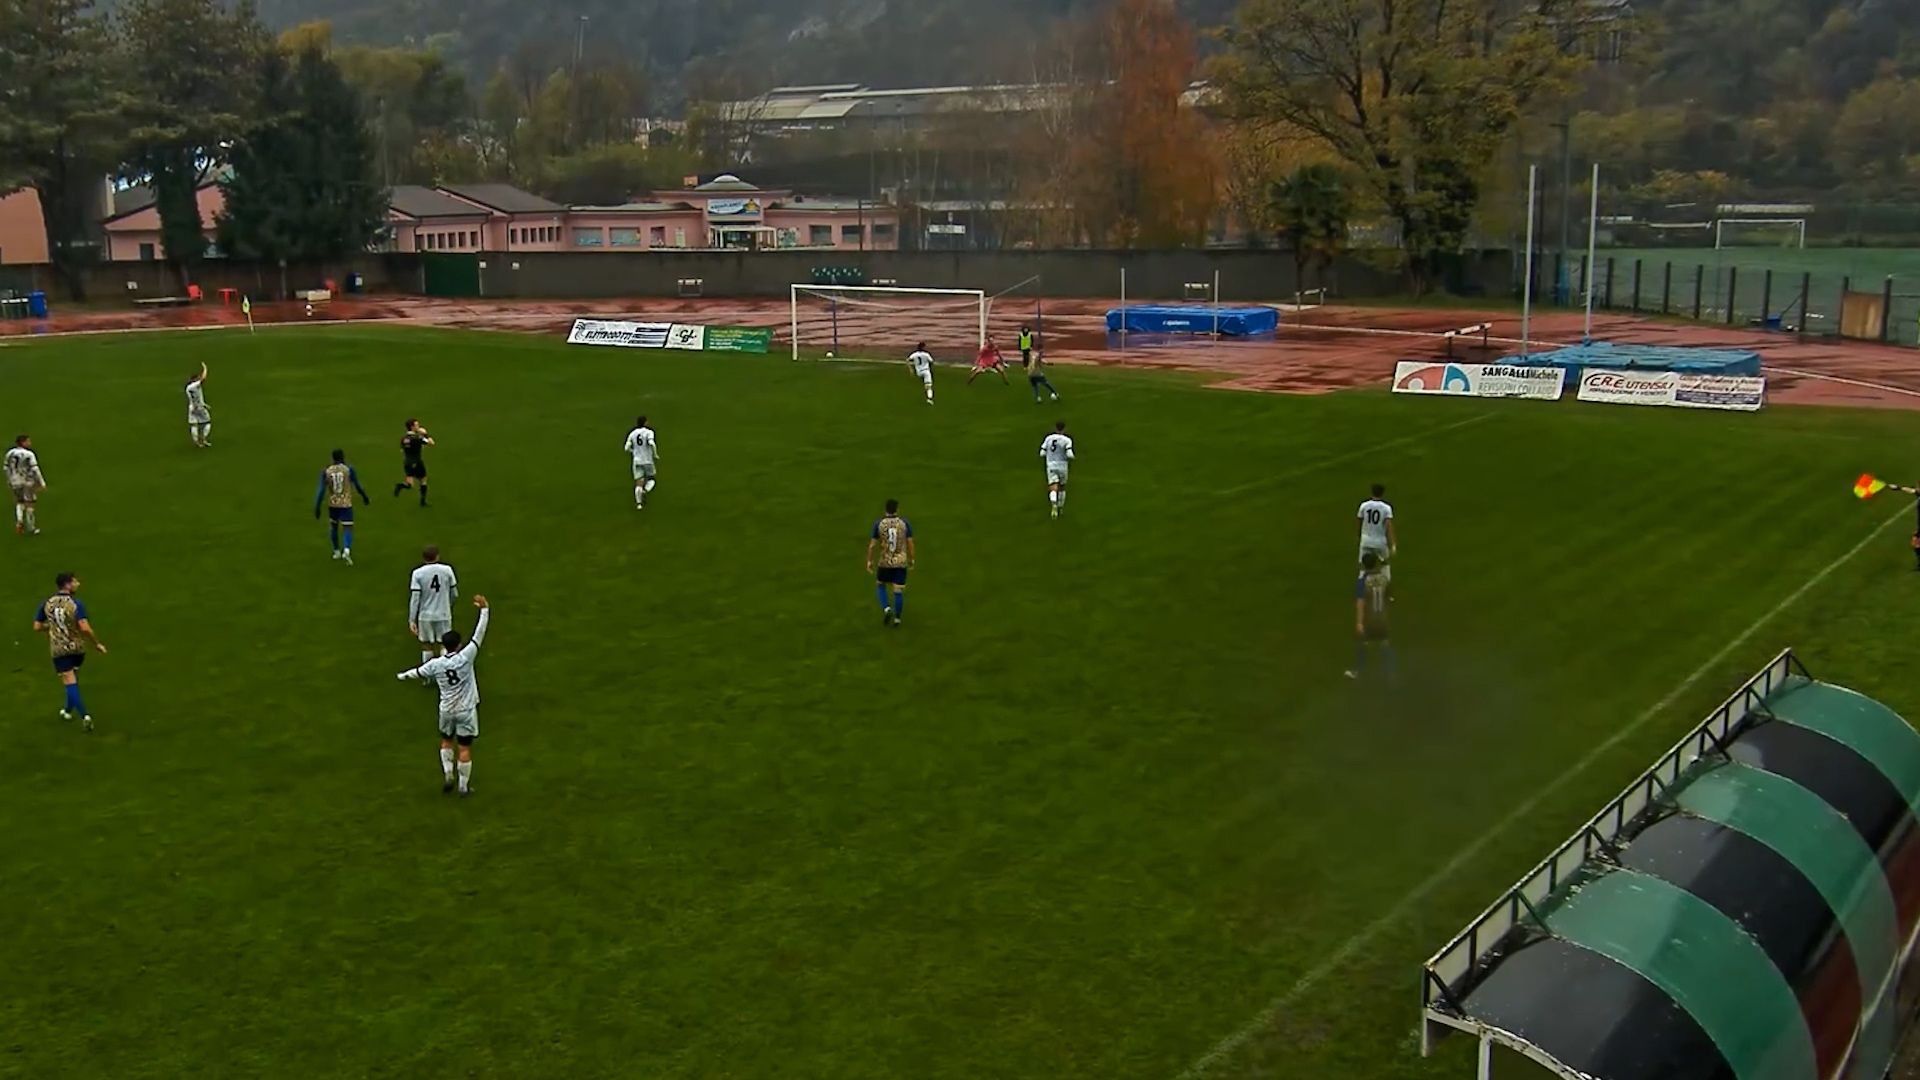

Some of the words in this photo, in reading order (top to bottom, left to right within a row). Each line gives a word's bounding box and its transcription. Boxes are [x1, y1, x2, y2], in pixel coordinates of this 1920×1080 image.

[1481, 367, 1529, 378] SANGALLI
[1626, 380, 1675, 390] UTENSILI
[636, 433, 643, 446] 6
[1050, 439, 1058, 452] 5
[1366, 509, 1380, 525] 10
[430, 574, 441, 593] 4
[445, 669, 461, 686] 8
